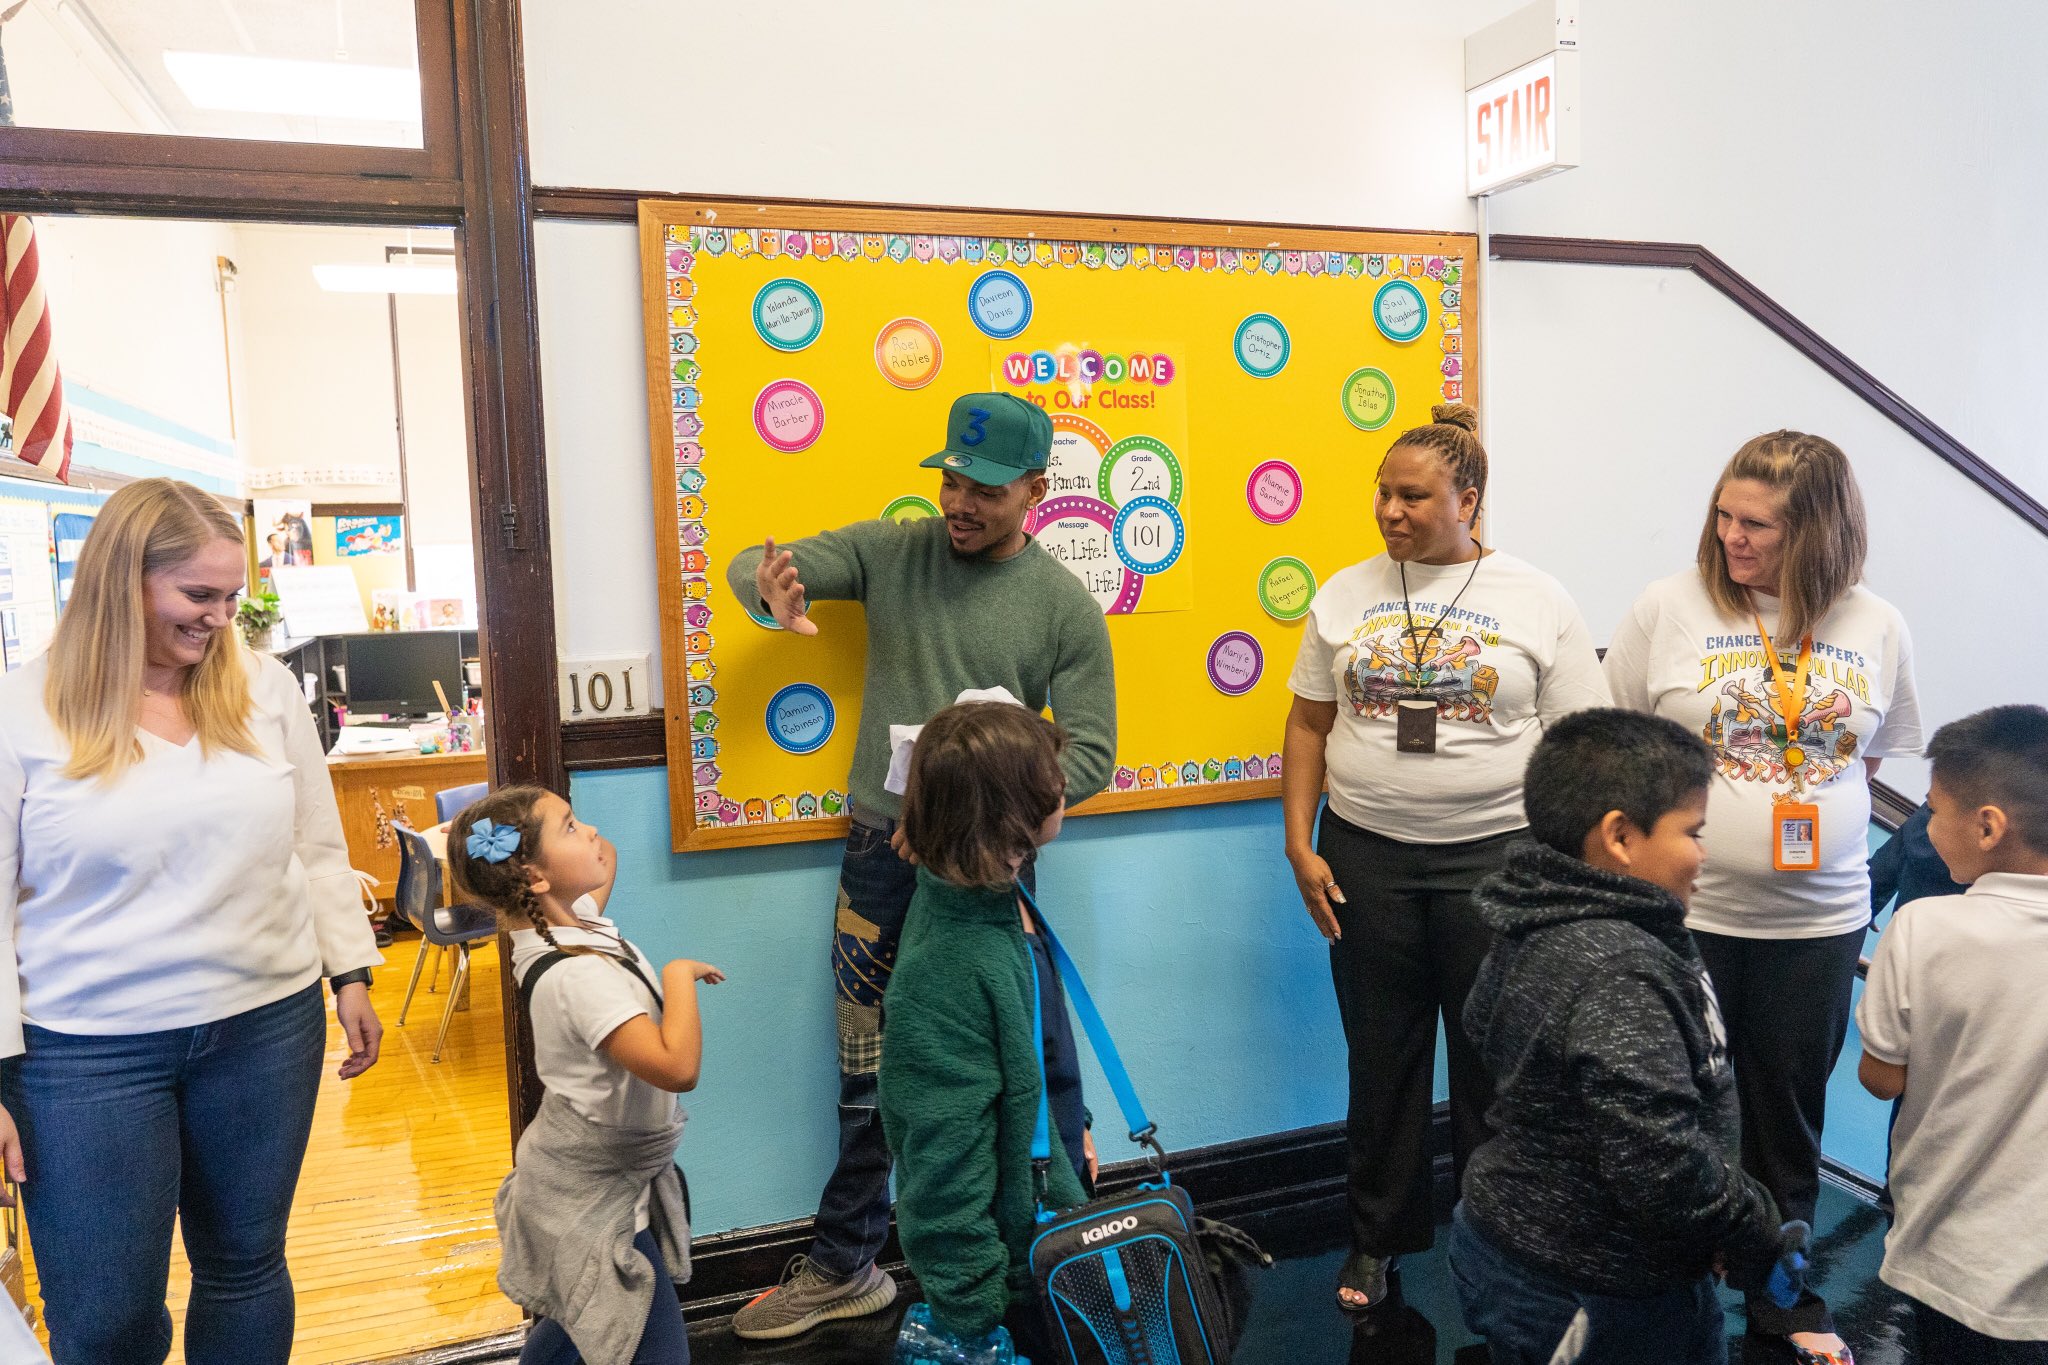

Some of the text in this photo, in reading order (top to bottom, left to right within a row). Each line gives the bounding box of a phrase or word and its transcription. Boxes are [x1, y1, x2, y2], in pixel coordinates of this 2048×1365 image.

[1477, 76, 1550, 175] STAIR
[766, 296, 799, 313] Yolanda
[1383, 296, 1406, 310] Saul
[987, 308, 1013, 321] Davis
[892, 336, 919, 350] Roel
[892, 353, 930, 369] Robles
[1006, 355, 1167, 380] WELCOME
[767, 394, 804, 412] Miracle
[1026, 389, 1155, 409] to Our Class!
[773, 413, 809, 429] Barber
[960, 408, 991, 447] 3
[1051, 438, 1077, 446] eacher
[1047, 472, 1091, 491] rkman
[1130, 466, 1160, 491] 2nd
[1259, 487, 1284, 507] Santos
[1057, 521, 1089, 529] Message
[1140, 511, 1159, 519] Room
[1133, 525, 1160, 547] 101
[1046, 534, 1108, 561] ive Life!
[1086, 567, 1122, 593] Life!
[1363, 601, 1500, 631] CHANCE THE RAPPER'S
[1344, 613, 1461, 645] INNOVATON
[1706, 635, 1761, 649] CHANCE
[1697, 650, 1827, 693] INNOVTION
[569, 670, 635, 713] 101
[778, 702, 815, 720] Damion
[781, 715, 823, 736] Robinson
[1081, 1215, 1138, 1245] IGLOO
